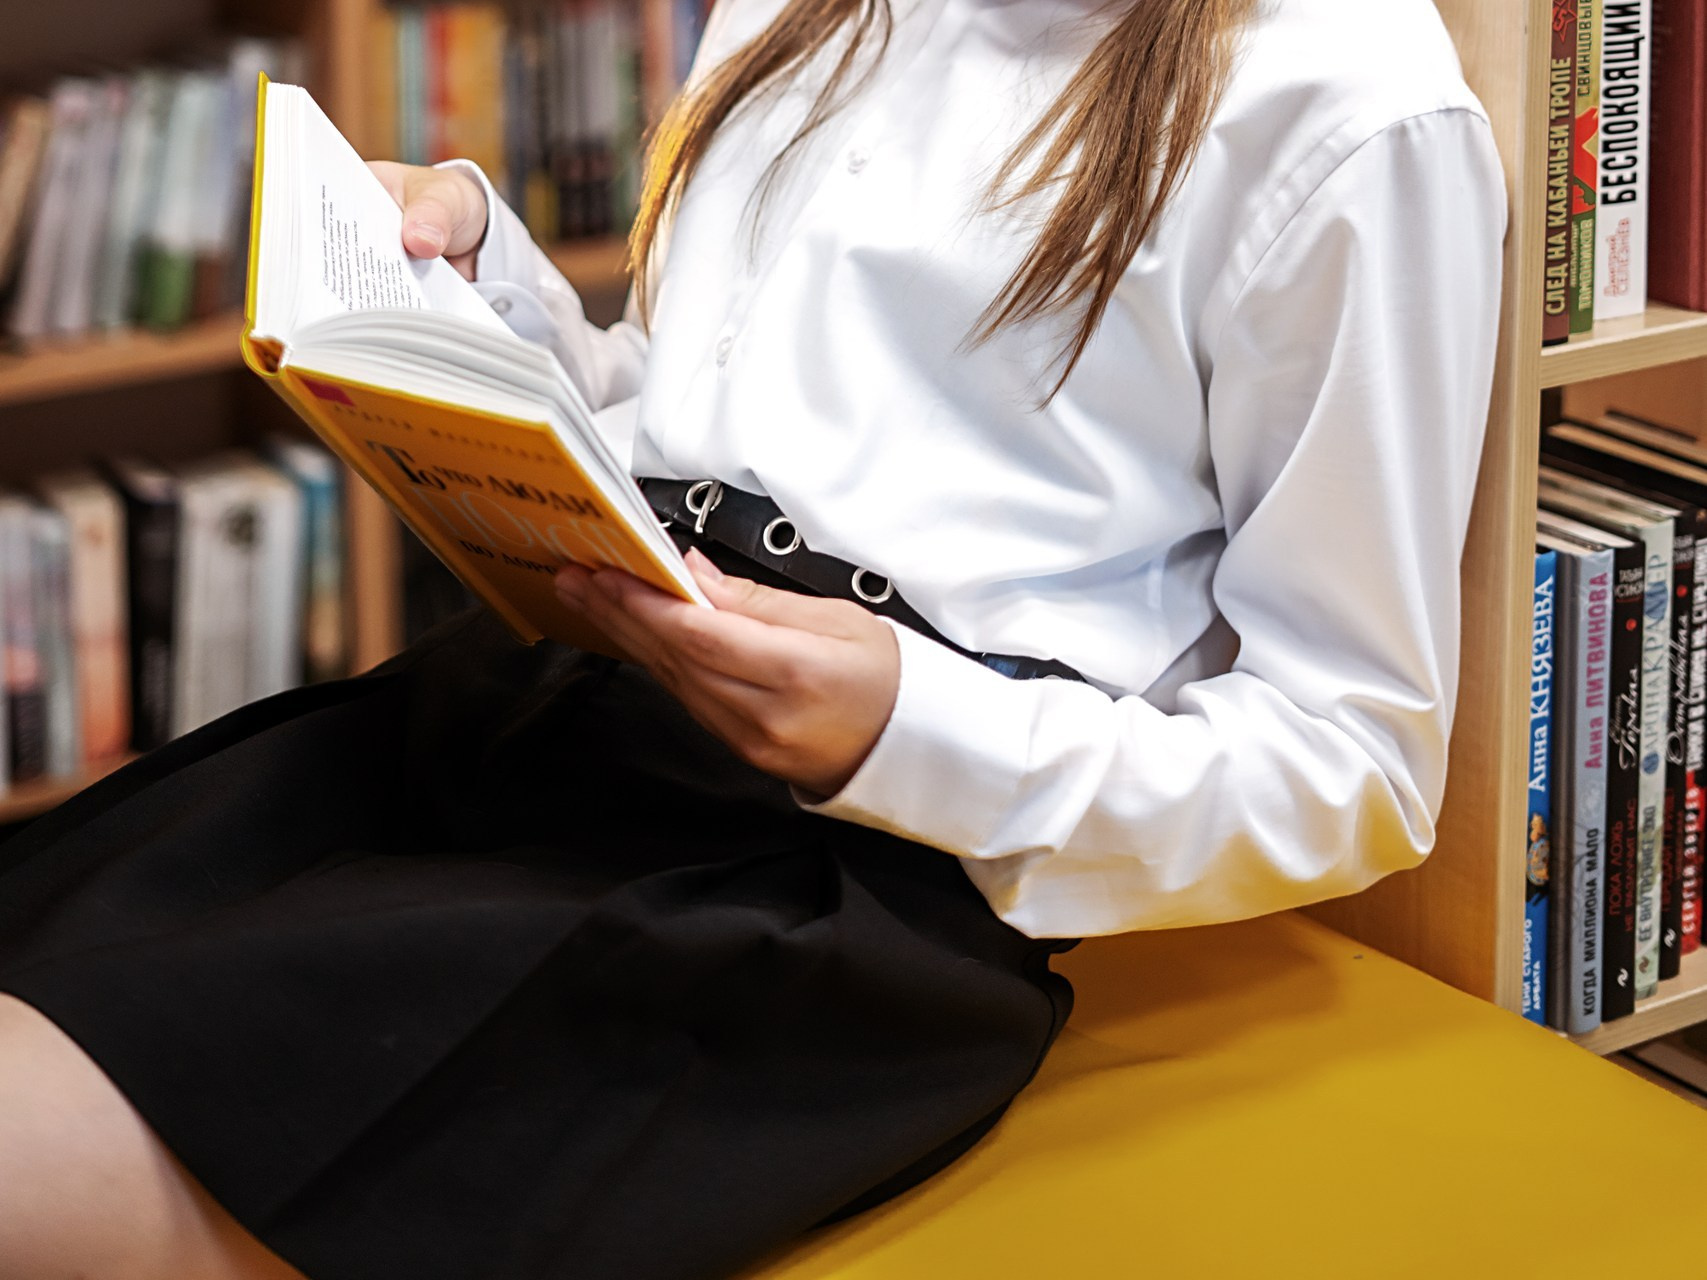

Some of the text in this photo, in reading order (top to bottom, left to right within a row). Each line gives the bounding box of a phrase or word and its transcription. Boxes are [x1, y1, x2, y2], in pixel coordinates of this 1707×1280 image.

[1550, 57, 1571, 119] ТРОПЕ
[1546, 263, 1568, 314] СЛЕД
[1547, 231, 1567, 259] НА
[1529, 575, 1553, 792] Анна КНЯЗЕВА
[1584, 573, 1608, 769] Анна ЛИТВИНОВА
[1608, 820, 1624, 916] ПОКА ЛОЖЬ
[1583, 828, 1600, 1016] КОГДА МИЛЛИОНА МАЛО
